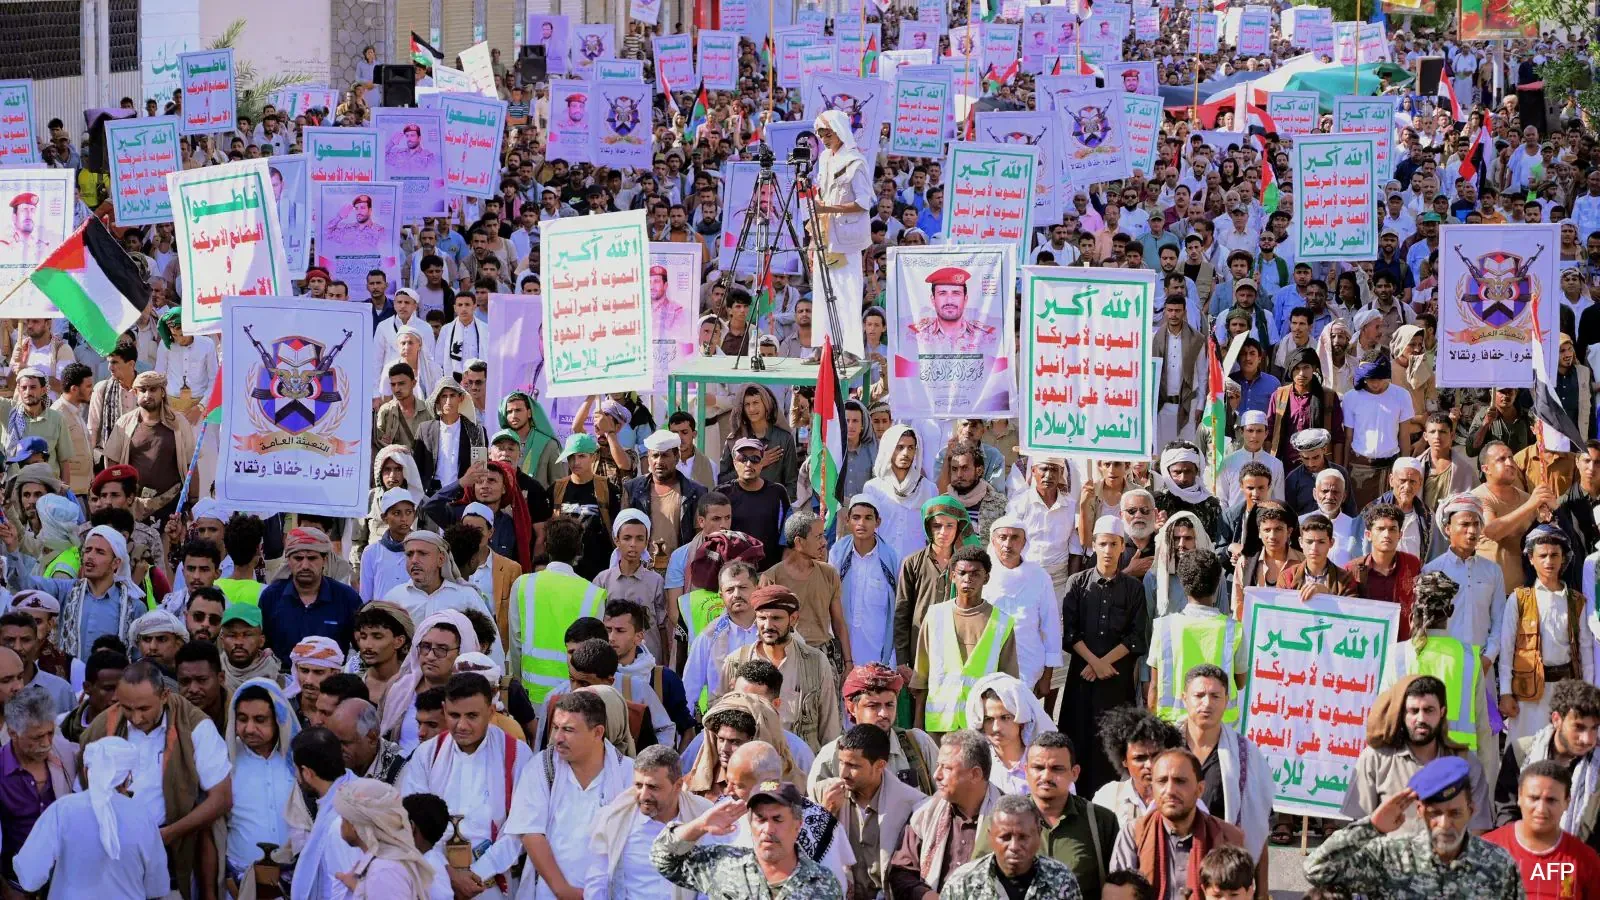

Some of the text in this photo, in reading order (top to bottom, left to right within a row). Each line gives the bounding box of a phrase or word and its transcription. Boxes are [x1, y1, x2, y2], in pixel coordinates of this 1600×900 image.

[187, 57, 226, 78] قاطعوا
[5, 91, 25, 106] الله
[446, 104, 496, 126] قاطعوا
[1343, 106, 1389, 123] الله أكبر
[152, 129, 172, 144] الله
[314, 139, 371, 161] قاطعوا
[1304, 145, 1368, 172] الله أكبر
[958, 156, 1028, 180] الله أكبر
[1304, 172, 1368, 189] الموت لأمريكا
[186, 185, 259, 223] قاطعوا
[1304, 211, 1369, 228] اللعنة على اليهود
[230, 222, 264, 249] البضائع
[554, 232, 637, 270] الله أكبر
[226, 256, 231, 273] و
[553, 268, 639, 292] الموت لأمريكا
[553, 294, 640, 319] الموت لإسرائيل
[1036, 285, 1099, 323] أكبر
[1101, 290, 1140, 318] الله
[554, 320, 640, 345] اللعنة على اليهود
[1037, 324, 1138, 350] الموت لأمريكا
[1472, 331, 1497, 342] العامة
[1036, 355, 1138, 380] الموت لإسرائيل
[1035, 385, 1138, 408] اللعنة على اليهود
[1035, 411, 1138, 444] النصر للإسلام
[259, 436, 330, 453] التعبئة العامة
[1257, 619, 1379, 658] الله أكبر
[1255, 659, 1375, 694] الموت لأمريكا
[1250, 692, 1314, 723] لإسرائيل
[1247, 727, 1291, 751] اليهود
[1296, 733, 1320, 755] على
[1307, 765, 1349, 795] نصر
